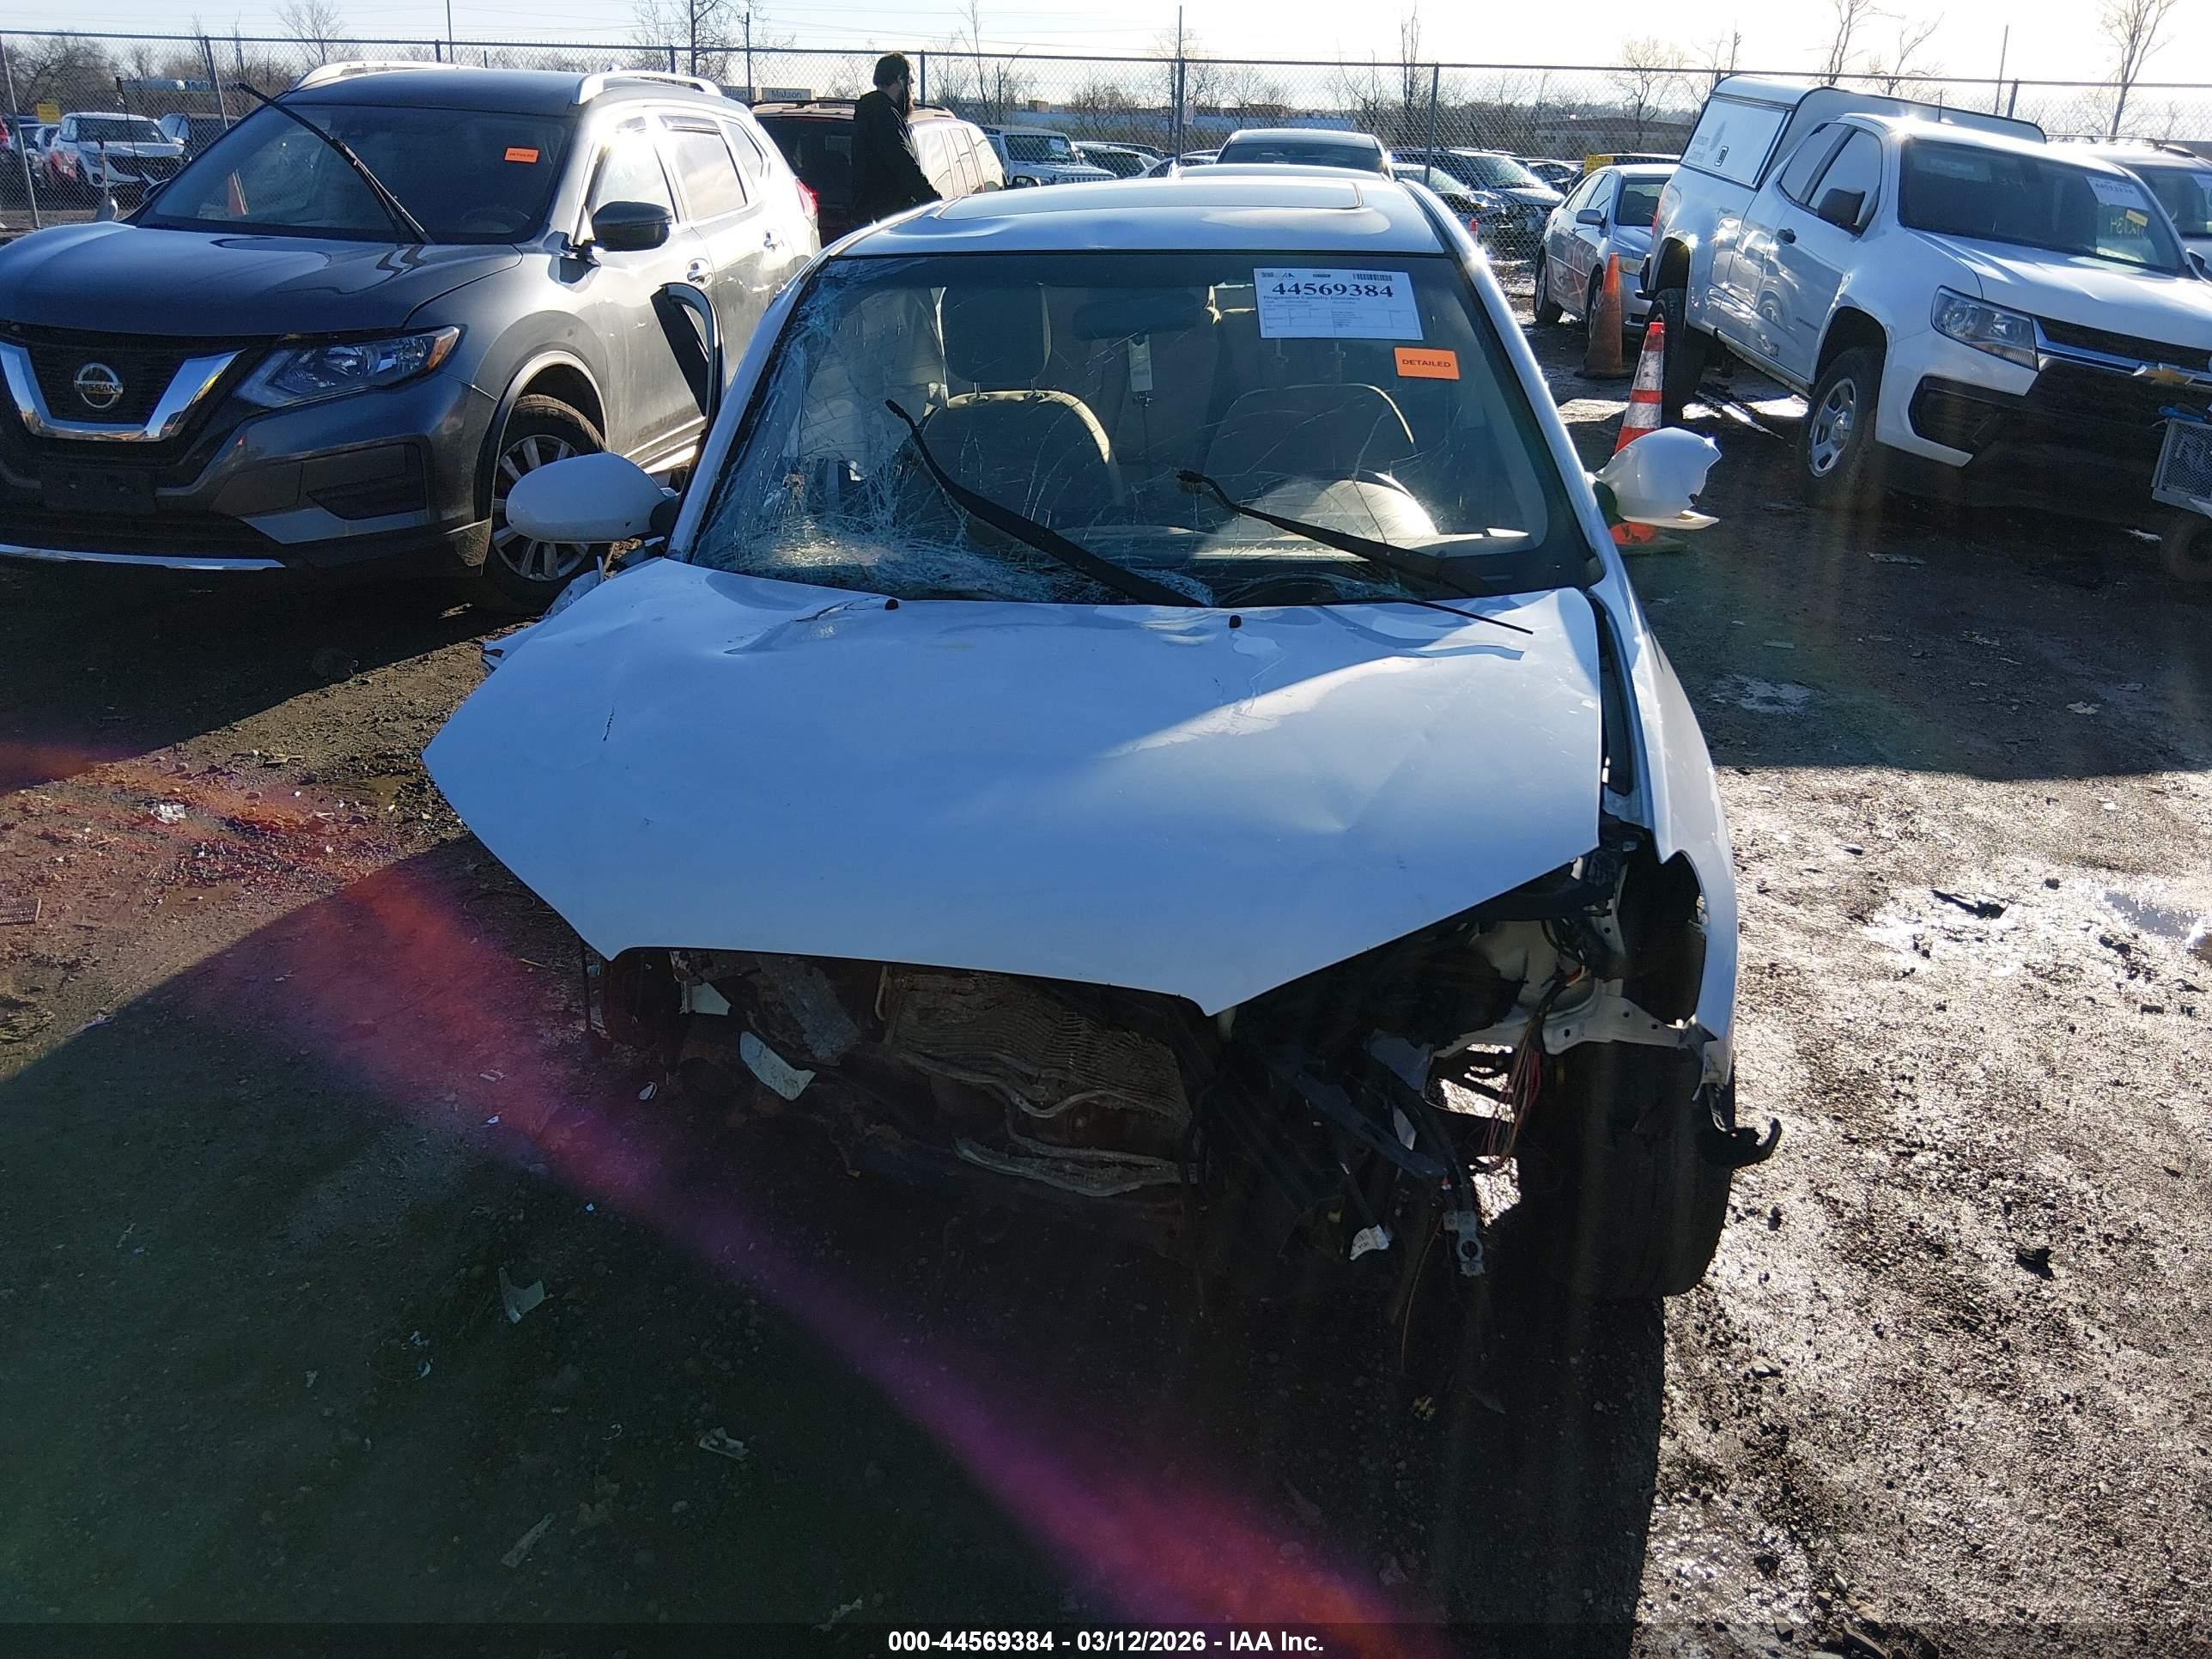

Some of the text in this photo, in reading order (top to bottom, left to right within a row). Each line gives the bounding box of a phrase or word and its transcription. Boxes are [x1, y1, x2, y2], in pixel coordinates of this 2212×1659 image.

[1272, 283, 1394, 297] 44569384
[1401, 359, 1451, 368] DETAILED
[76, 383, 118, 392] NISSAN
